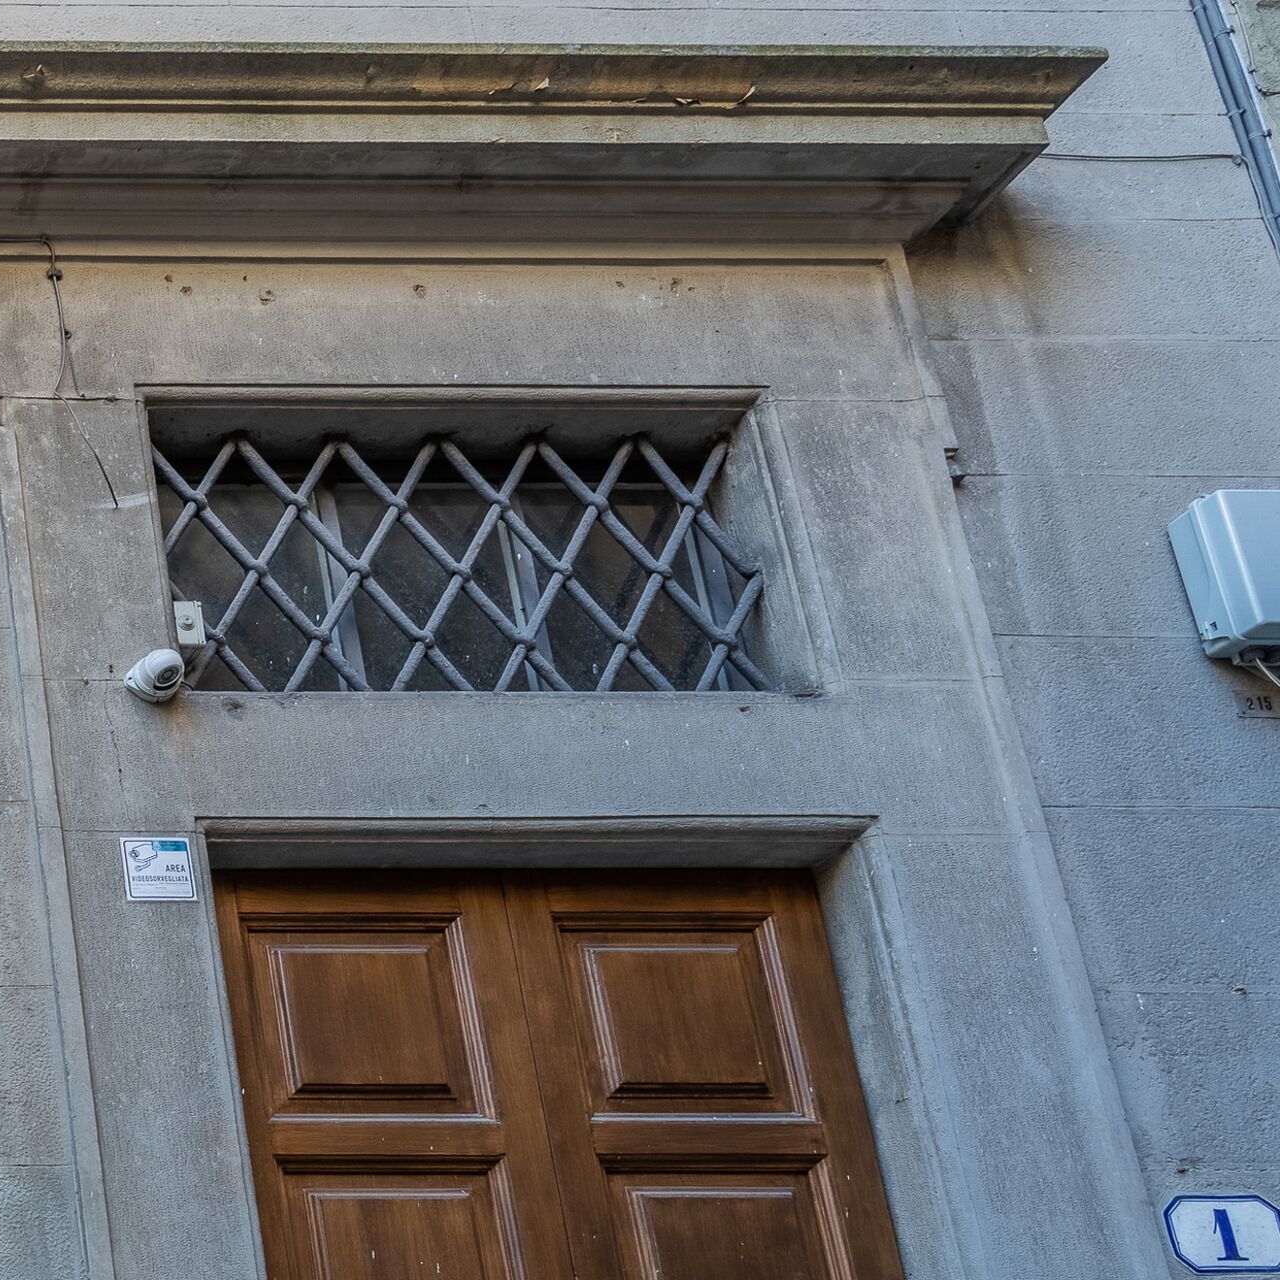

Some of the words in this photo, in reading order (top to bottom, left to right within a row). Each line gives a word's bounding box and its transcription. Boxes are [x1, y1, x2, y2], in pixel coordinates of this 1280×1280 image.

[1246, 696, 1272, 710] 215
[165, 864, 186, 873] AREA
[1213, 1208, 1249, 1261] 1
